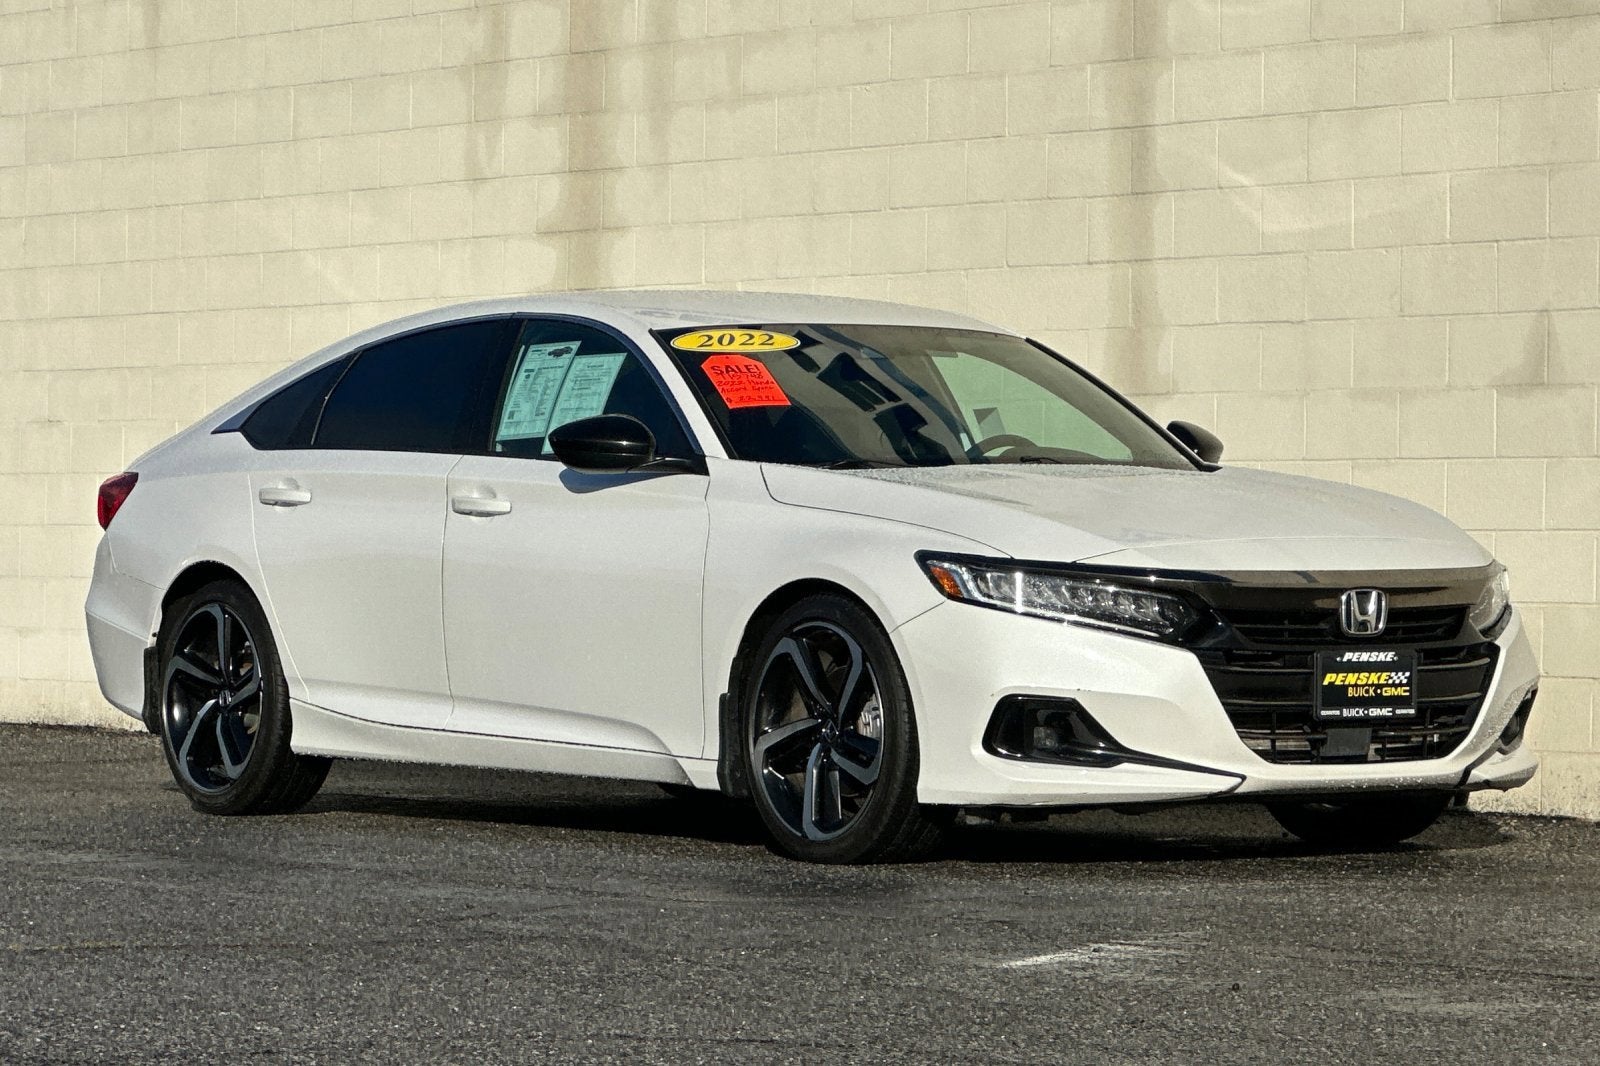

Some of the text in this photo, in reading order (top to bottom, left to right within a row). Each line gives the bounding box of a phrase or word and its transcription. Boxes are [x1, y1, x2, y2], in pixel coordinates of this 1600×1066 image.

[697, 333, 775, 348] 2022
[710, 364, 762, 374] SALE!
[1342, 651, 1396, 662] PENSKE
[1322, 672, 1391, 685] PENSKE
[1347, 686, 1410, 697] BUICK GMC
[1342, 707, 1364, 717] BUICK
[1369, 707, 1393, 716] GMC
